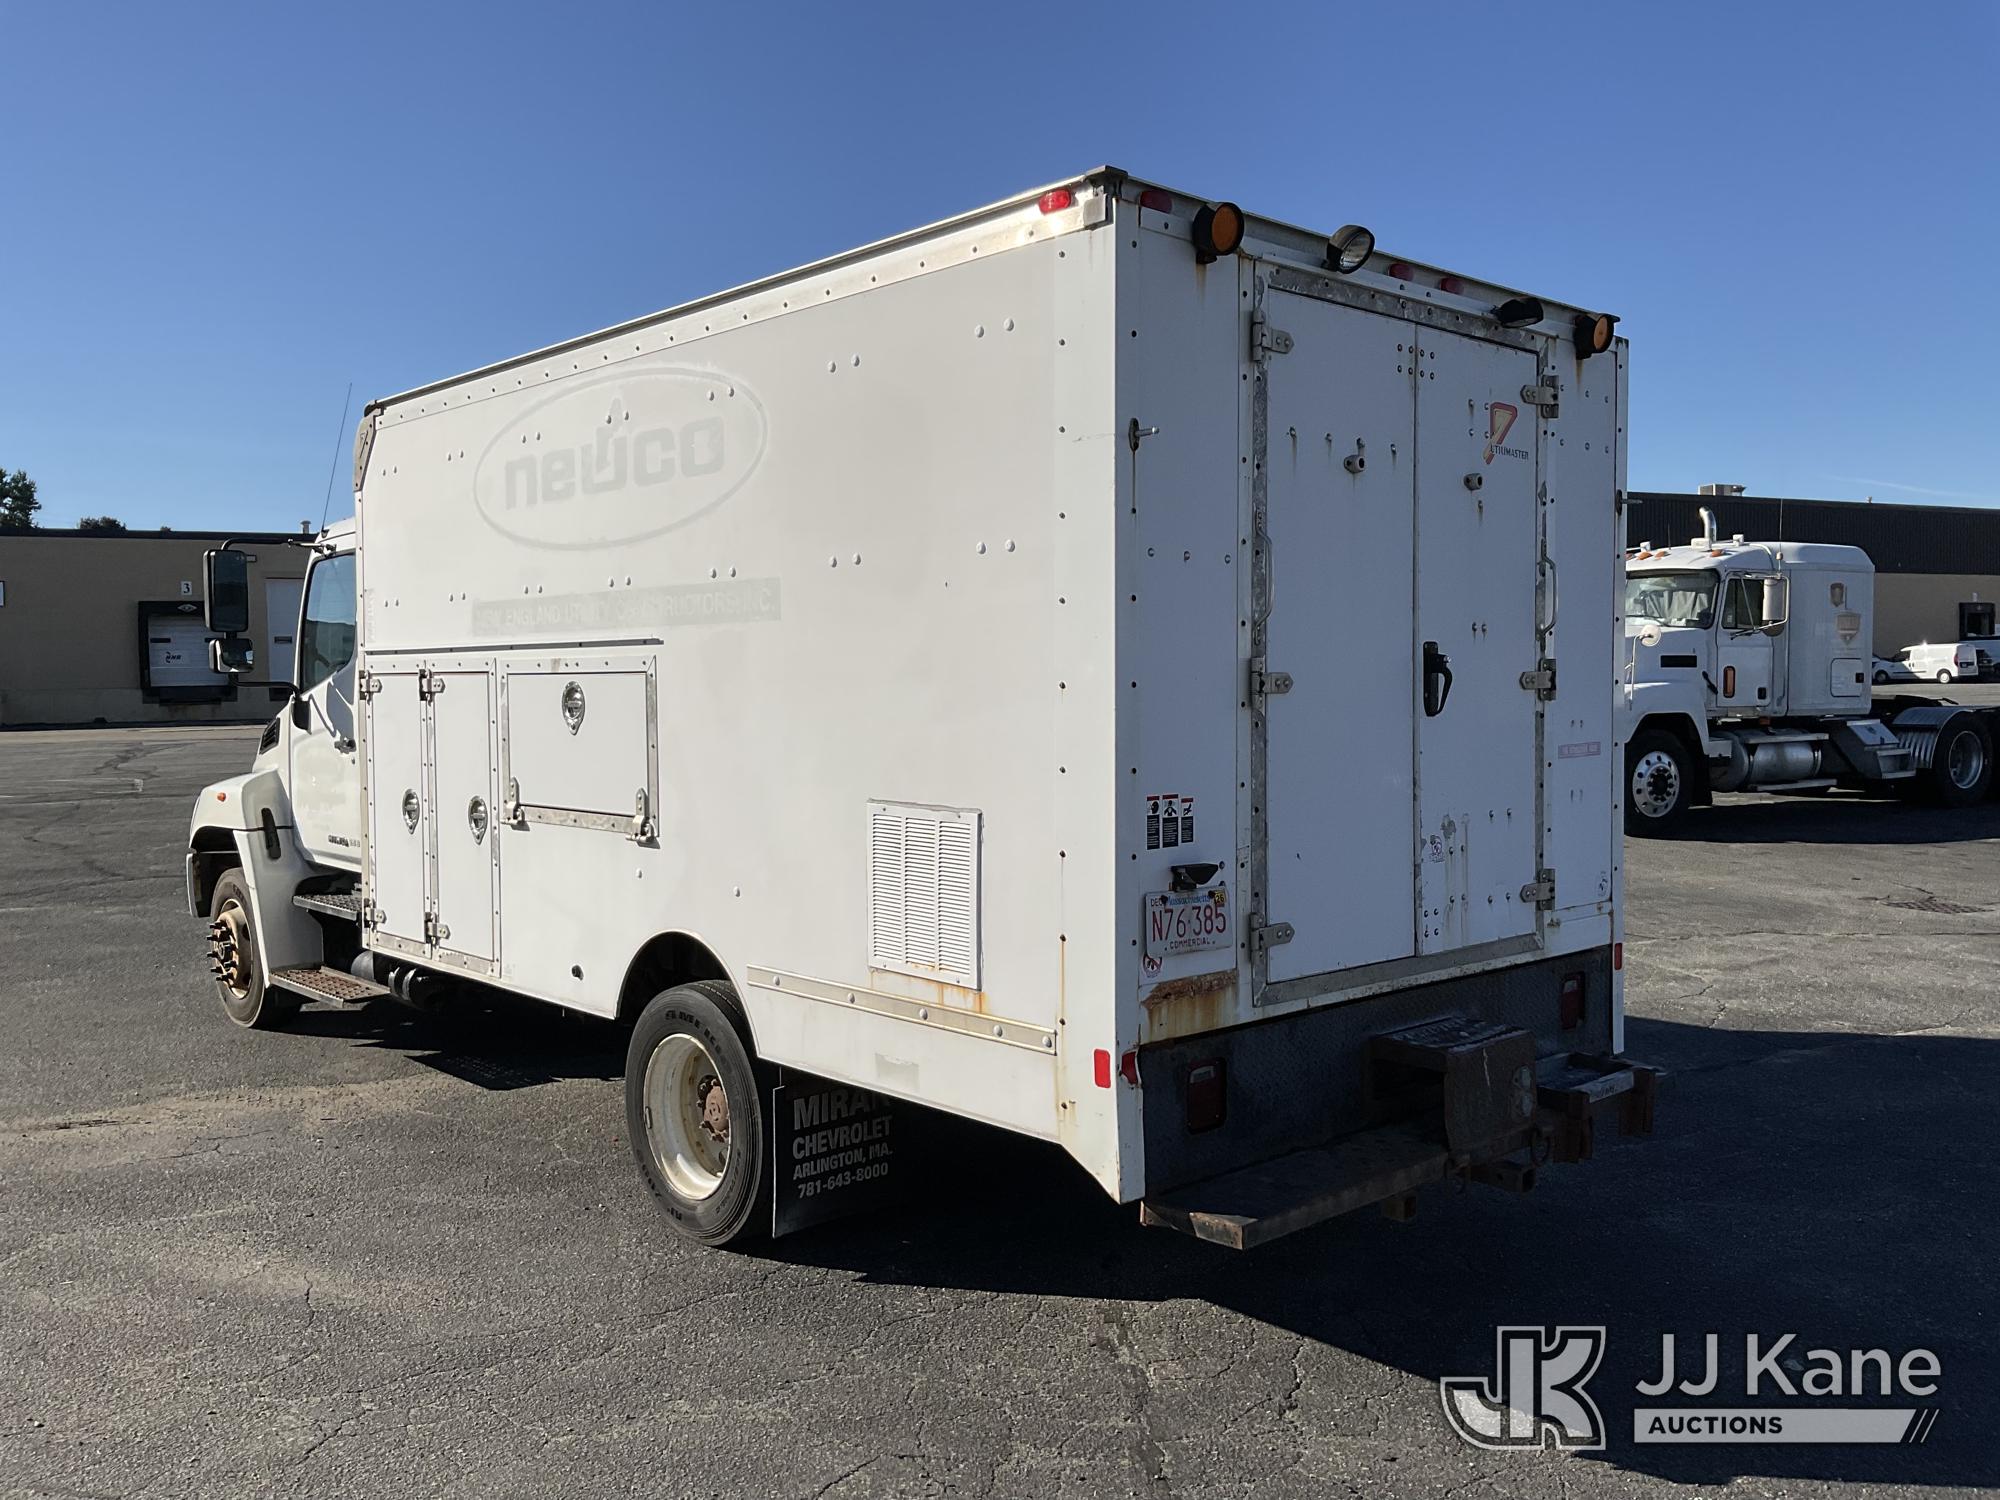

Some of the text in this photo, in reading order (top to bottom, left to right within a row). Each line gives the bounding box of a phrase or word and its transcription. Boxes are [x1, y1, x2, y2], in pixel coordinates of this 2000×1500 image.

[183, 583, 191, 594] 3
[1169, 936, 1211, 950] COMMERCIAL
[792, 1115, 893, 1159] CHEVROLET
[792, 1142, 894, 1180] ARLINGTON, MA.
[797, 1162, 889, 1199] 781-643-8000
